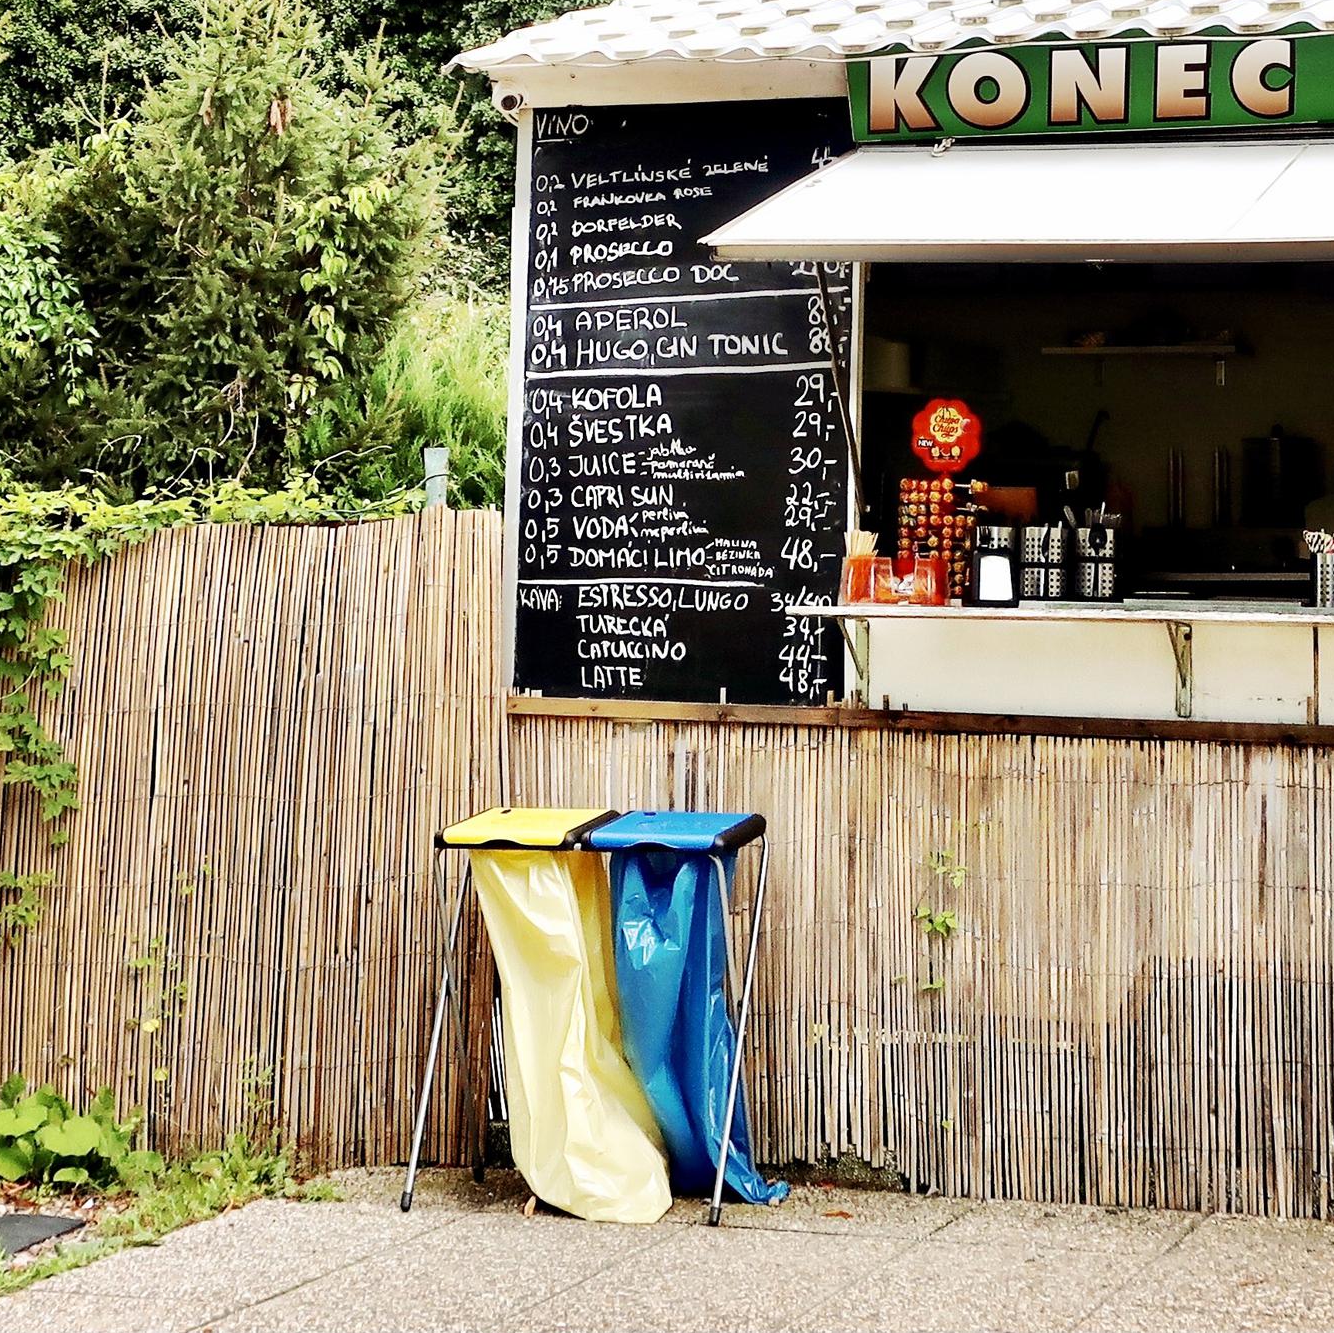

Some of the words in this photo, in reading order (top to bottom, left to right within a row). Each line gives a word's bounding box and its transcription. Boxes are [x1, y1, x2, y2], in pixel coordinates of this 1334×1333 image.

[867, 39, 1296, 133] KONEC
[535, 114, 589, 140] VÍNO
[571, 158, 693, 189] VELTLÍNSKÉ
[571, 214, 683, 237] DORFELDER
[570, 240, 674, 266] PROSECCO
[571, 266, 681, 293] PROSECCO
[690, 263, 740, 284] DOC
[532, 314, 563, 342] 0,4
[575, 306, 688, 332] APEROL
[530, 338, 567, 368] 0,4
[707, 332, 788, 357] TONIC
[531, 387, 563, 420] 0,4
[571, 383, 663, 411] KOFOLA
[530, 421, 559, 450] 0,4
[568, 413, 673, 448] ŠVESTKA
[529, 456, 562, 483] 0,3
[568, 452, 636, 477] JUICE
[528, 488, 563, 514] 0,3
[570, 485, 625, 510] CAPRI
[631, 483, 674, 507] SUN
[525, 518, 560, 543] 0,5
[572, 515, 630, 540] VODA
[525, 544, 562, 570] 0,5
[654, 546, 706, 569] LIMO
[576, 613, 670, 638] TURECKÁ
[577, 639, 687, 661] CAPUCCINO
[581, 666, 644, 689] LATTE
